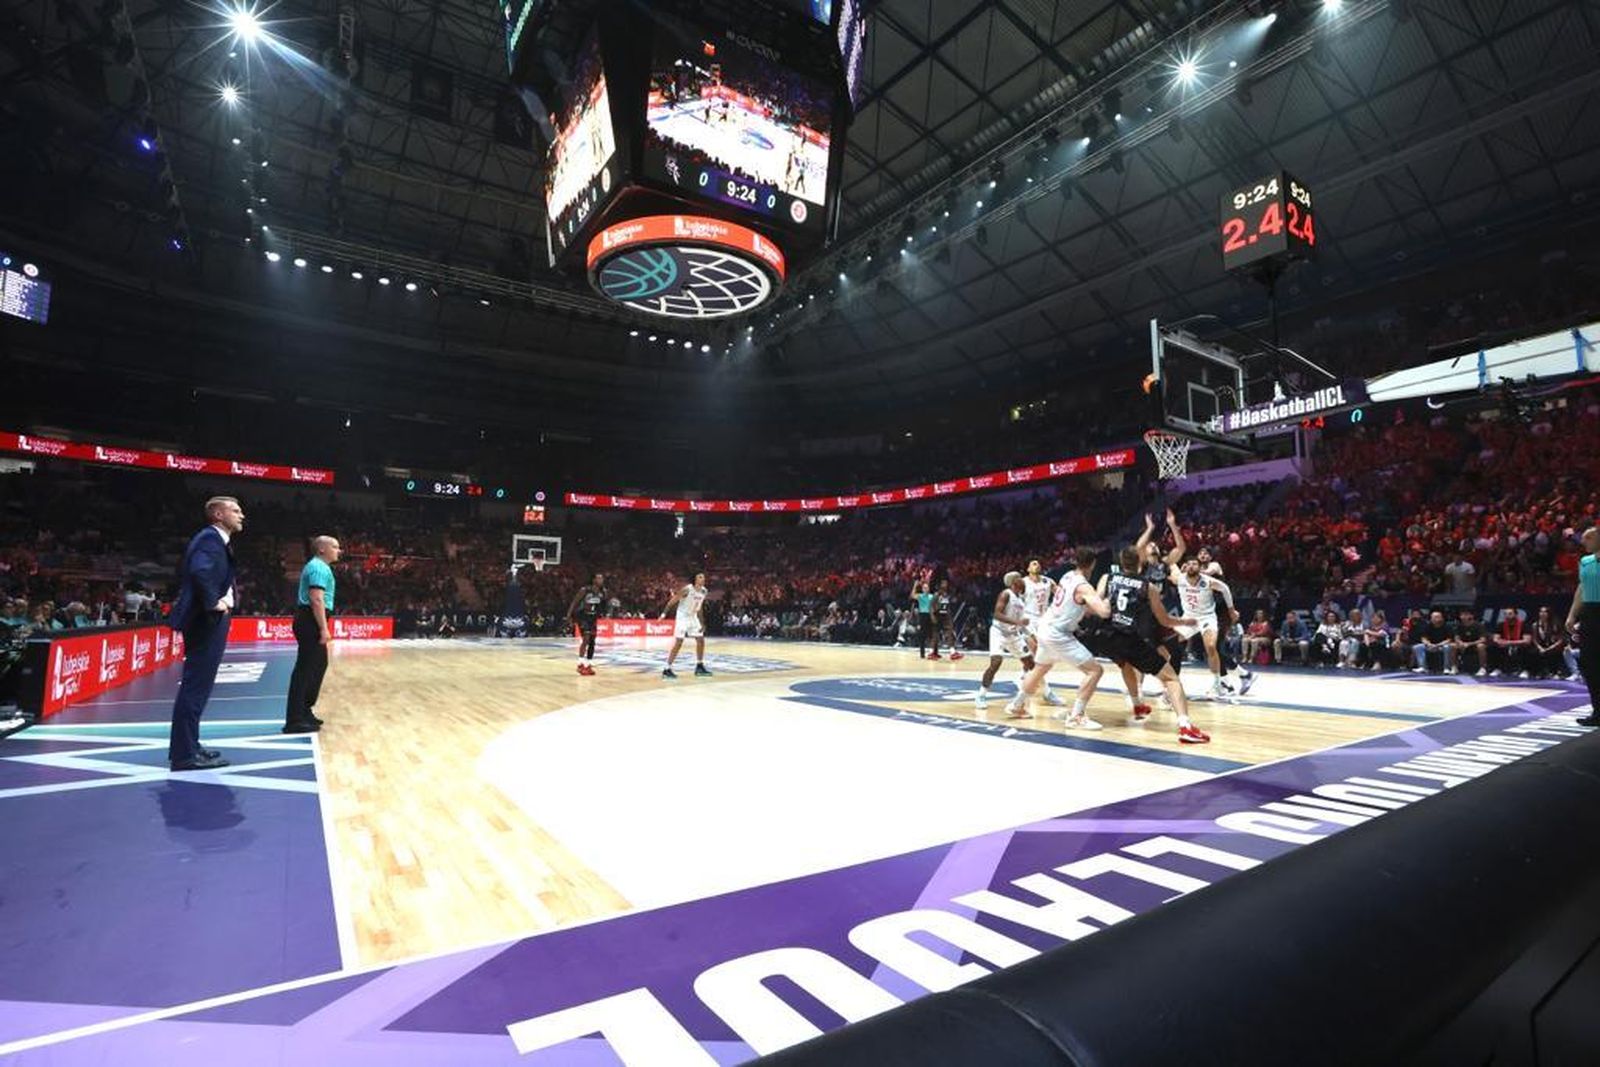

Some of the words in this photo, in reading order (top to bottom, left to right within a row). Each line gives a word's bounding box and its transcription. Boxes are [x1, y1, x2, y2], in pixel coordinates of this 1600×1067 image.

[699, 172, 709, 187] 0
[727, 181, 758, 203] 9:24
[767, 195, 776, 208] 0
[1233, 178, 1280, 210] 9:24
[1290, 181, 1311, 208] 9:24
[1223, 202, 1284, 254] 2.4
[1287, 203, 1316, 247] 2.4
[1229, 385, 1347, 430] #BasketballCL
[1302, 416, 1325, 429] 2.4
[406, 480, 415, 491] 0
[434, 482, 460, 495] 9:24
[496, 488, 504, 499] 0
[1117, 588, 1129, 611] 5
